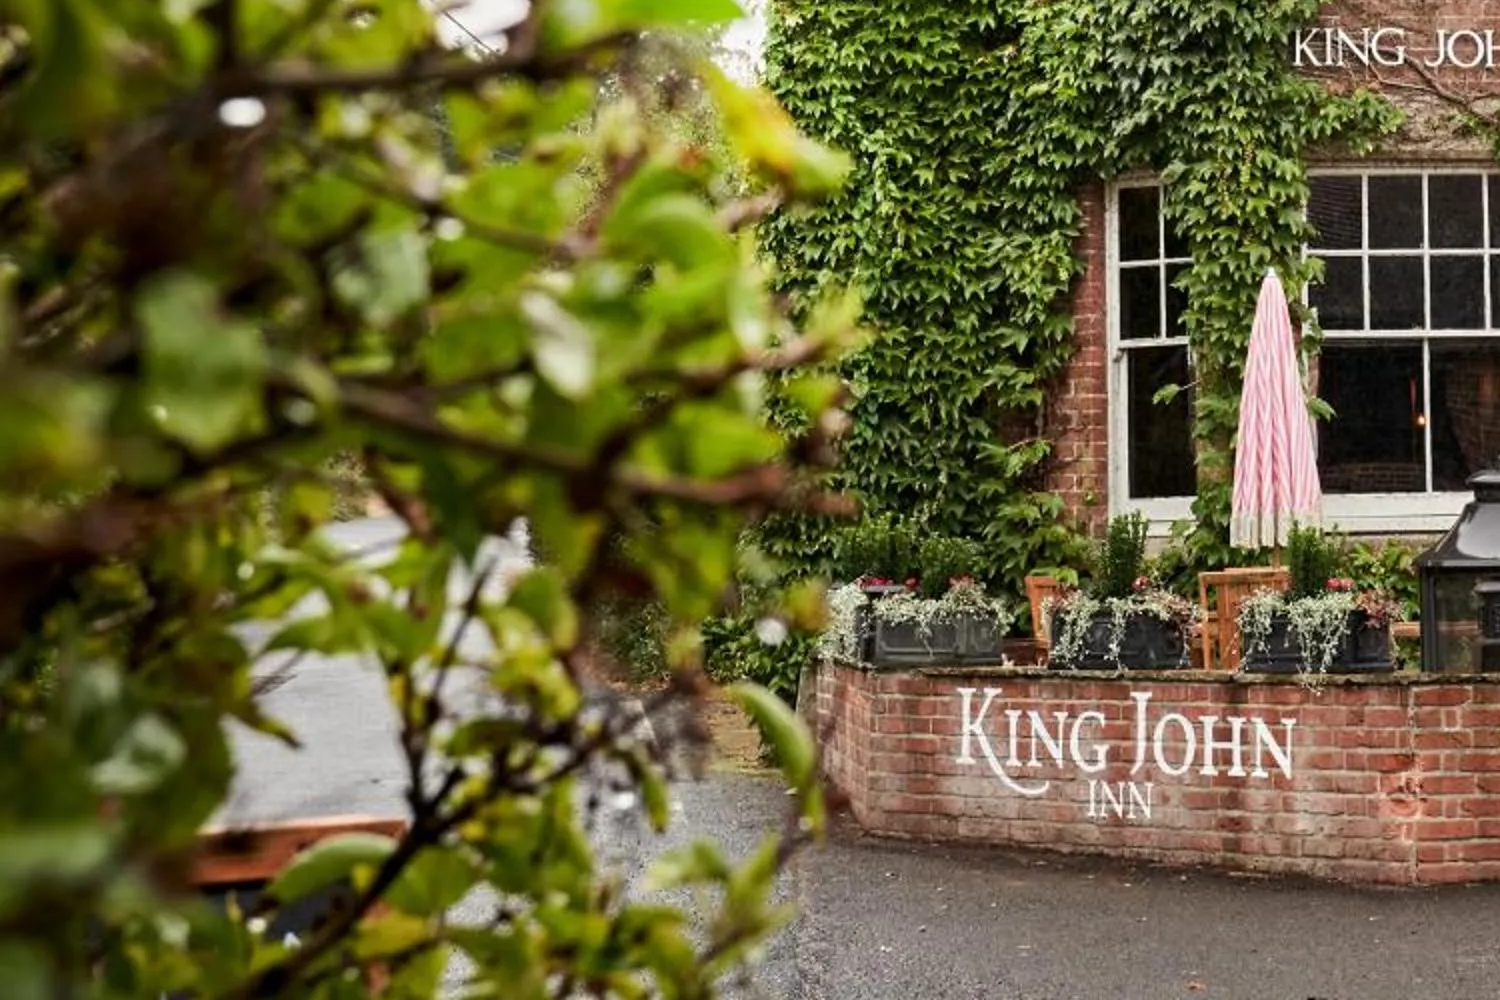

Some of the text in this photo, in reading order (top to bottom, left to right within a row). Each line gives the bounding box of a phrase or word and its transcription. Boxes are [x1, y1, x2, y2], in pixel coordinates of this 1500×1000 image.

[1292, 27, 1406, 67] KING
[955, 686, 1297, 795] KING JOHN
[1086, 779, 1155, 820] INN
